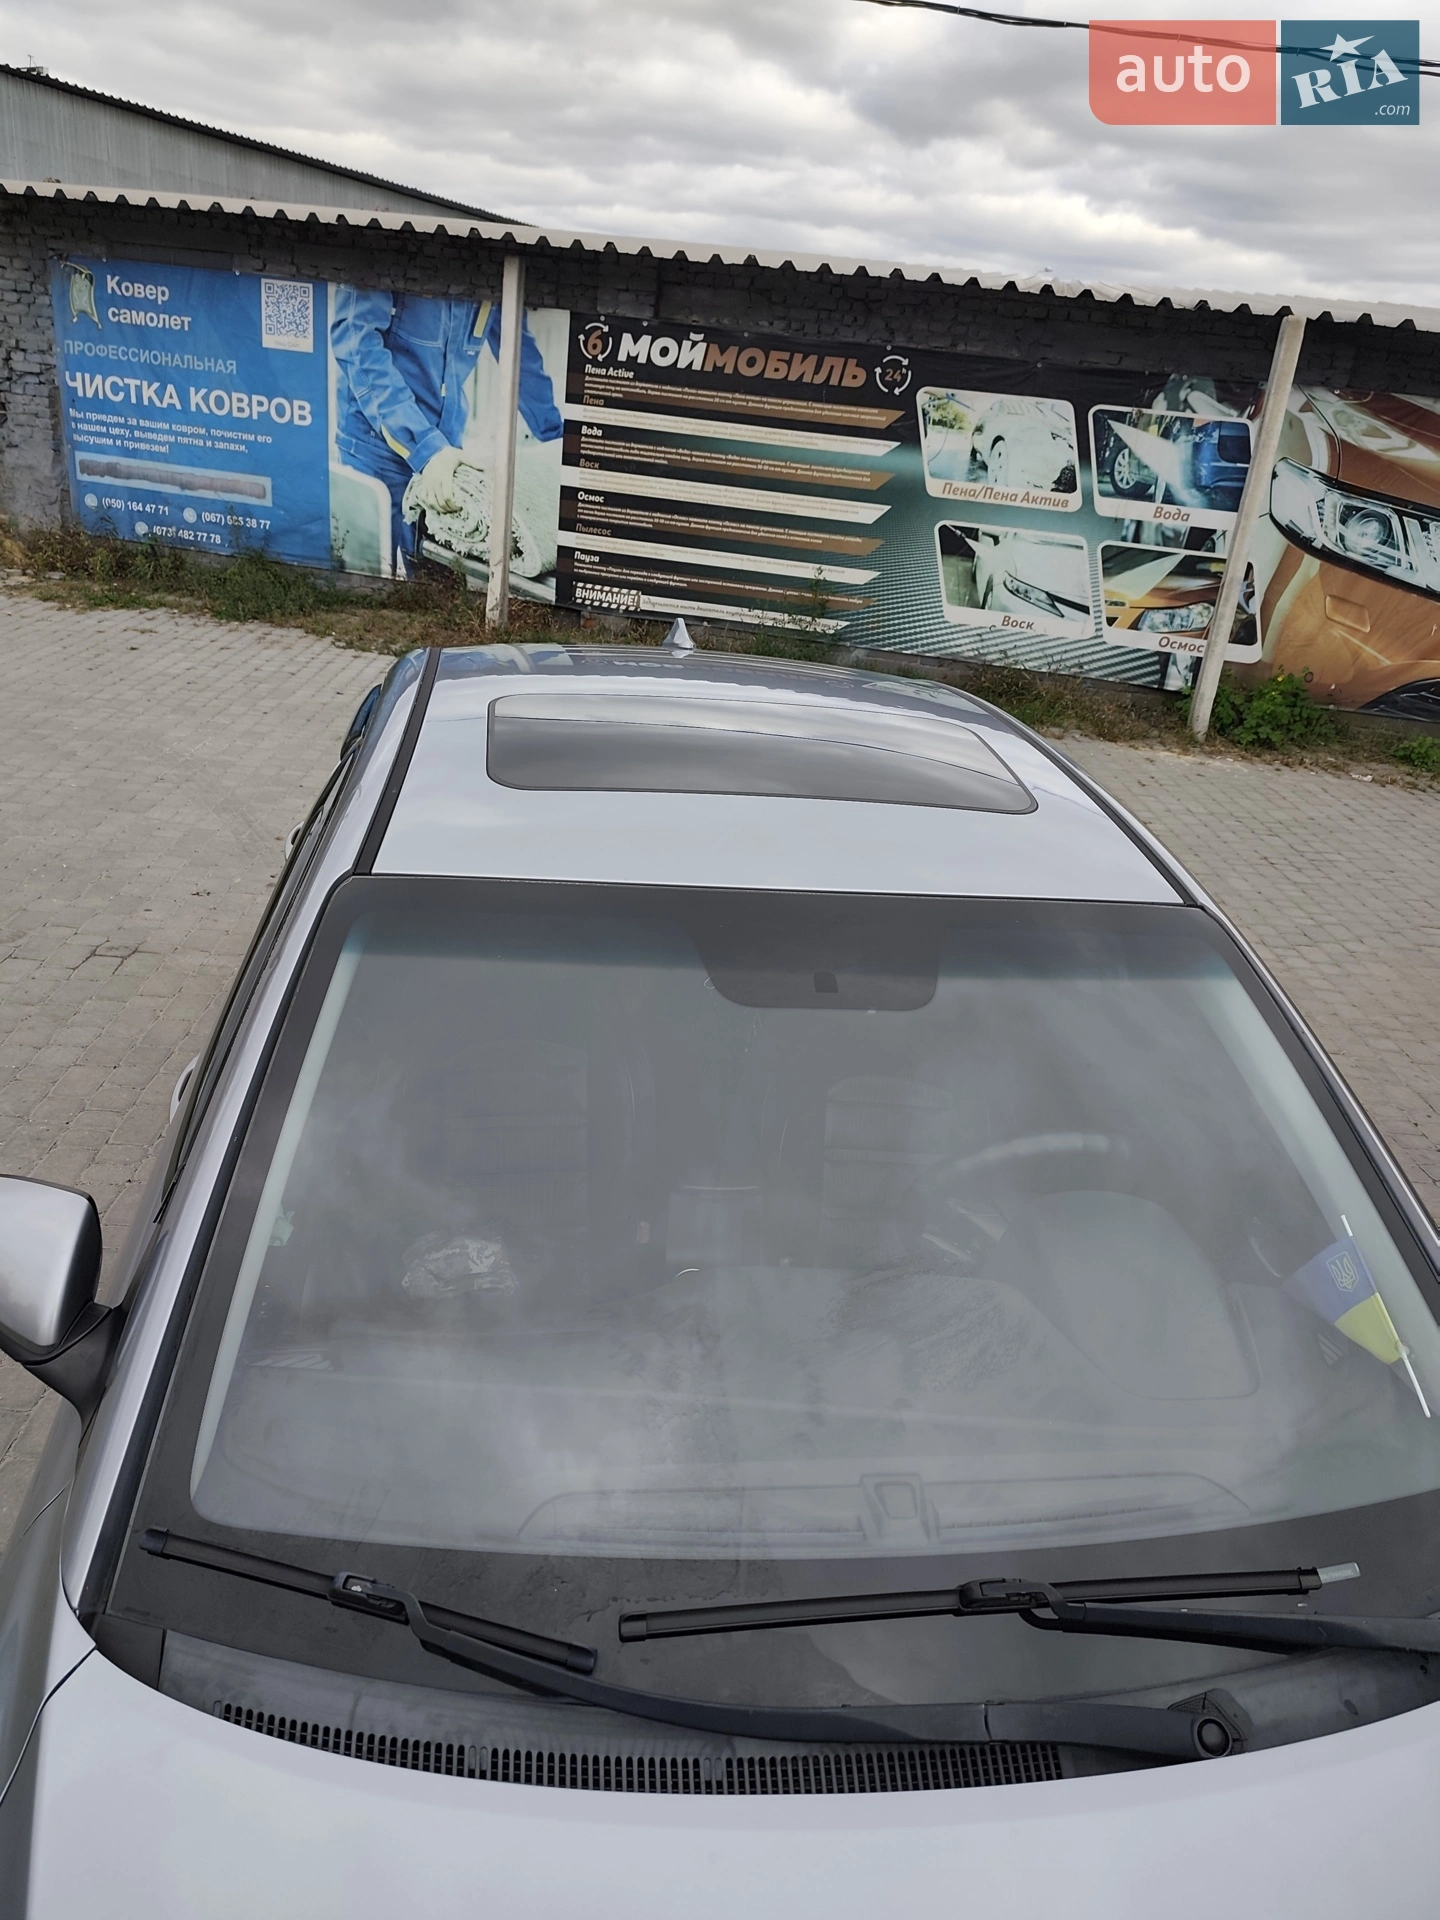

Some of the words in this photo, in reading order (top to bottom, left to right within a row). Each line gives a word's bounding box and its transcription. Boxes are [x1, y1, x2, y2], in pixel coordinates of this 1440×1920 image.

[106, 275, 170, 305] Ковер
[107, 306, 192, 332] самолет
[64, 339, 237, 375] ПРОФЕССИОНАЛЬНАЯ
[585, 364, 606, 376] Пена
[607, 366, 635, 379] Active
[65, 371, 182, 410] ЧИСТКА
[190, 386, 313, 427] КОВРОВ
[583, 394, 605, 406] Пена
[69, 408, 84, 420] Мы
[86, 412, 125, 425] приедем
[127, 417, 137, 426] за
[139, 418, 170, 431] вашим
[171, 423, 209, 437] ковром,
[210, 428, 255, 442] почистим
[256, 435, 273, 445] его
[581, 425, 603, 437] Вода
[72, 434, 114, 448] высушим
[115, 438, 122, 447] и
[123, 439, 169, 454] привезем!
[77, 423, 107, 434] нашем
[108, 426, 132, 439] цеху,
[134, 429, 175, 443] выведем
[177, 436, 204, 447] пятна
[206, 438, 212, 448] и
[213, 440, 249, 454] запахи,
[579, 457, 600, 469] Воск
[577, 491, 605, 503] Осмос
[942, 482, 1019, 504] Пена/Пена
[1020, 490, 1070, 509] Актив
[102, 497, 125, 512] (050)
[126, 501, 143, 512] 164
[145, 503, 156, 514] 47
[158, 505, 169, 516] 71
[1152, 505, 1191, 523] Вода
[202, 511, 225, 526] (067)
[246, 517, 257, 528] 38
[259, 519, 271, 530] 77
[575, 523, 612, 537] Пылесос
[177, 529, 195, 541] 482
[196, 531, 208, 542] 77
[209, 533, 222, 545] 78
[574, 550, 600, 563] Пауза
[575, 587, 639, 607] ВНИМАНИЕ!
[1001, 614, 1035, 631] Воск
[1158, 635, 1205, 654] Осмос
